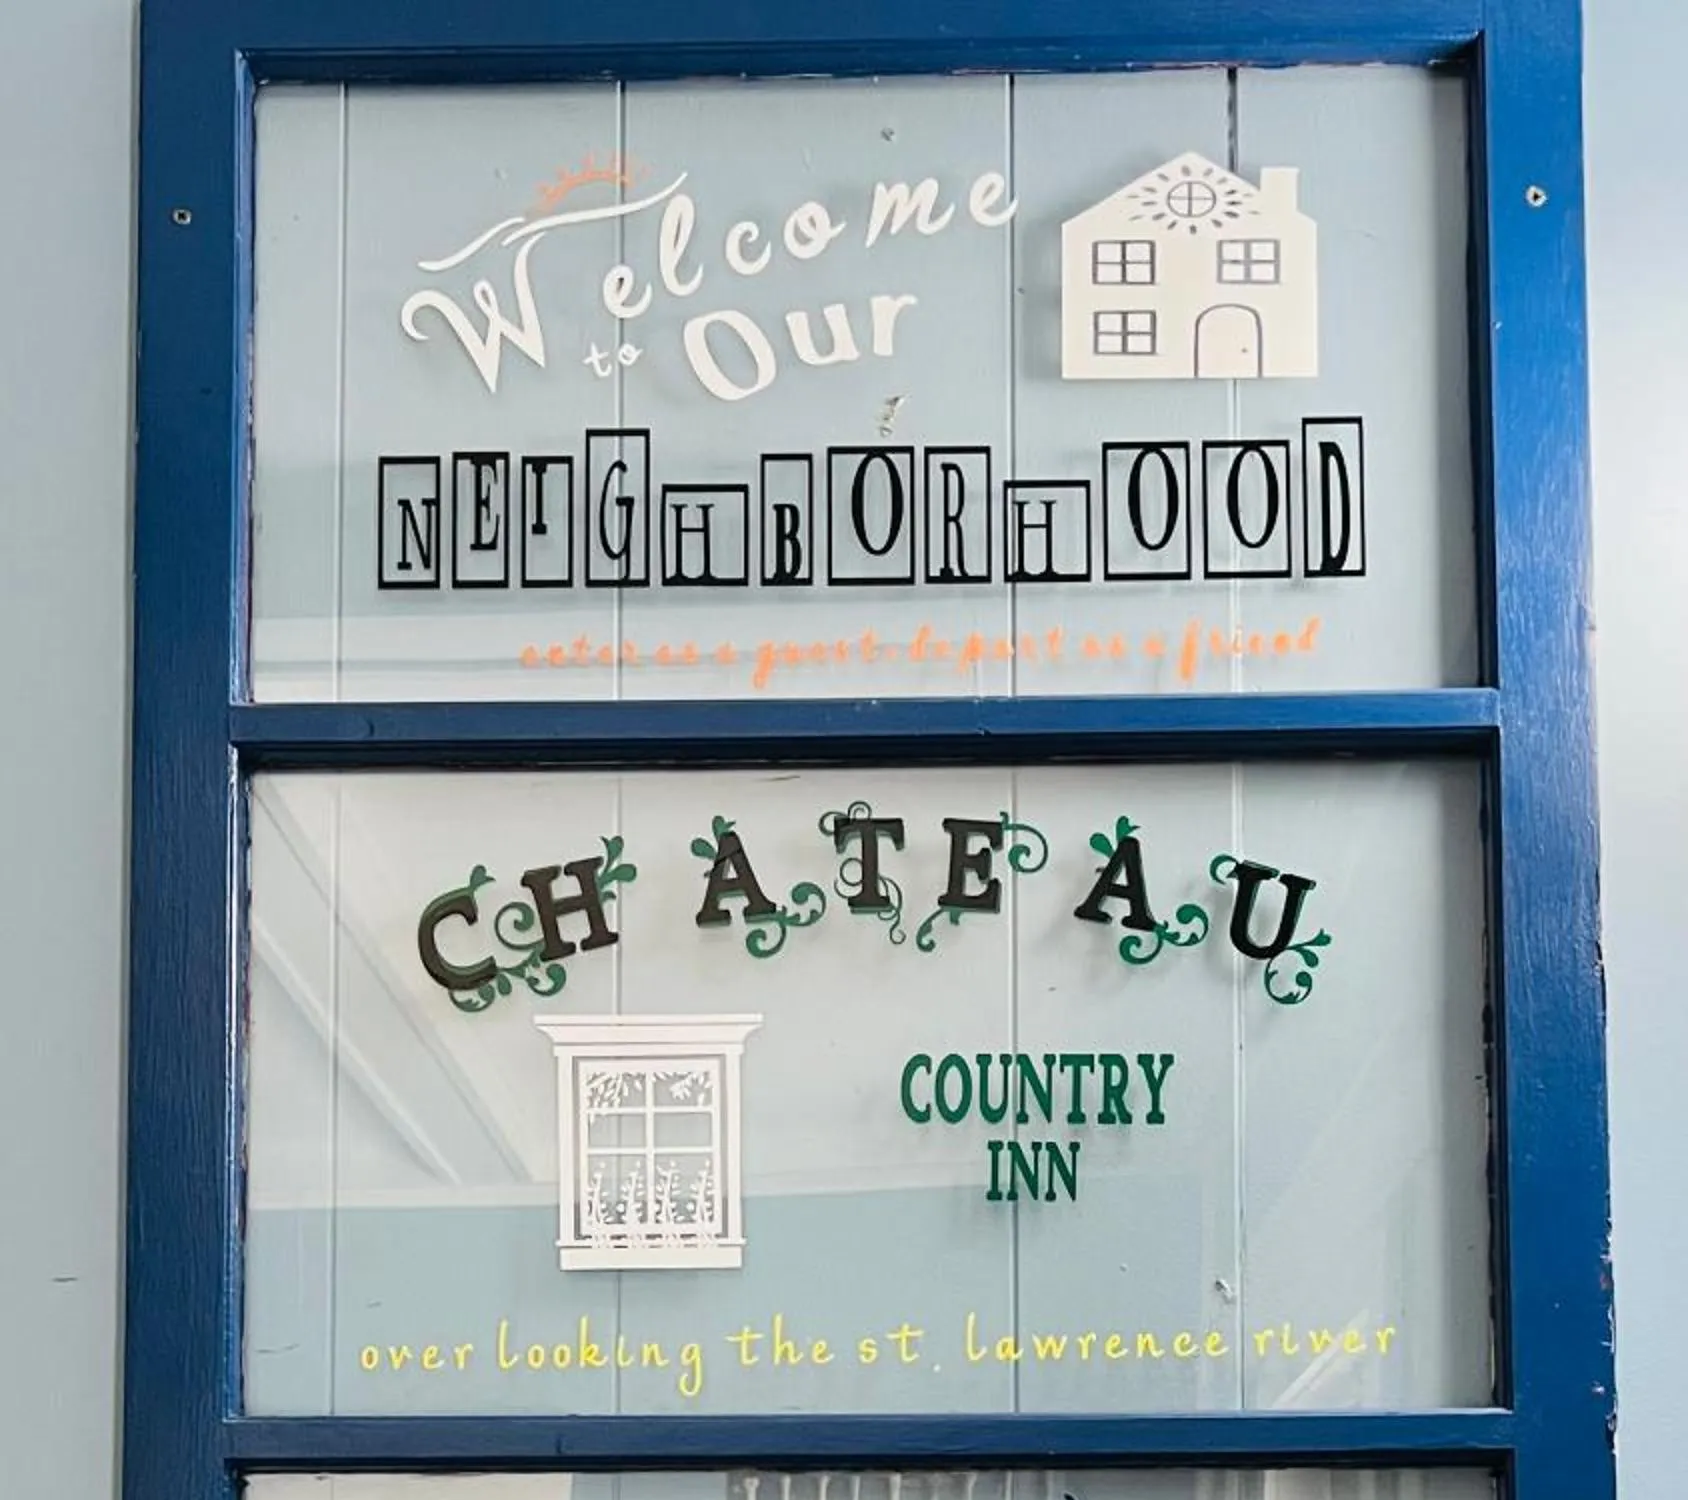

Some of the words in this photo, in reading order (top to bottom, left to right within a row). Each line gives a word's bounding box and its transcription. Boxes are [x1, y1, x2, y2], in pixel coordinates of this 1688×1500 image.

[401, 172, 1018, 394] Welcome
[583, 340, 643, 378] to
[682, 294, 918, 401] Our
[395, 440, 1354, 582] NEIGHBORHOOD
[418, 814, 1318, 994] CHATEAU
[900, 1053, 1174, 1125] COUNTRY
[986, 1141, 1080, 1202] INN
[724, 1312, 836, 1367] the
[964, 1311, 1230, 1362] lawrence
[1253, 1321, 1397, 1356] river
